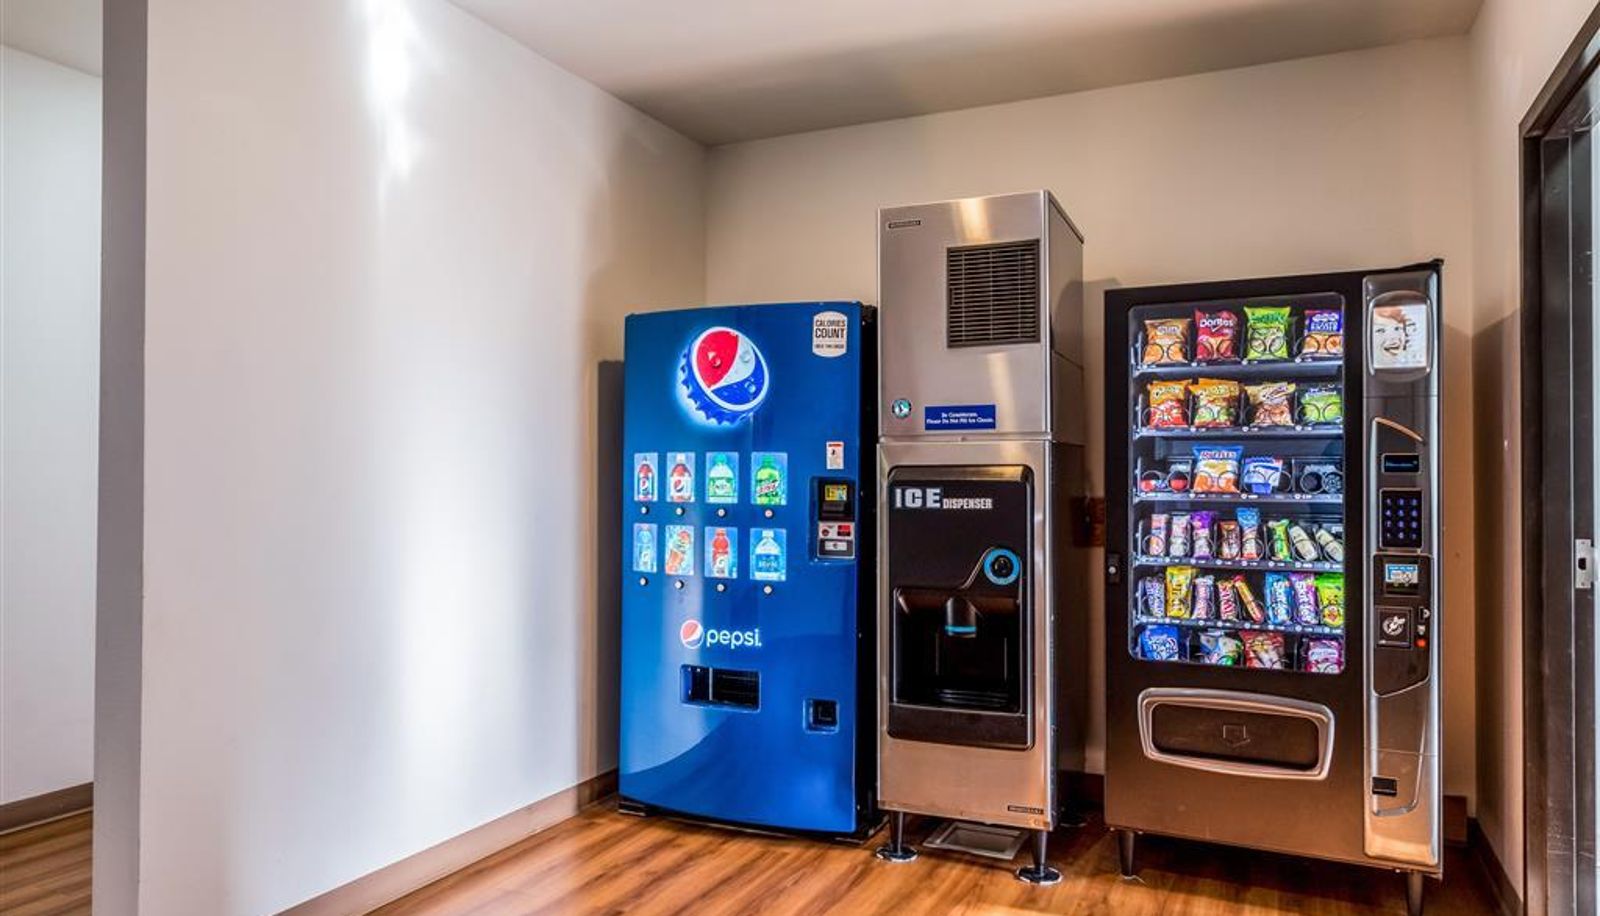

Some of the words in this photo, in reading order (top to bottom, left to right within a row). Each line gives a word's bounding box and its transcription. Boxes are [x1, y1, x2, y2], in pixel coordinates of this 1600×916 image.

[1200, 318, 1234, 330] Doritos
[815, 327, 845, 338] COUNT
[895, 487, 941, 508] ICE
[943, 498, 993, 509] DISPENSER
[705, 628, 760, 650] pepsi
